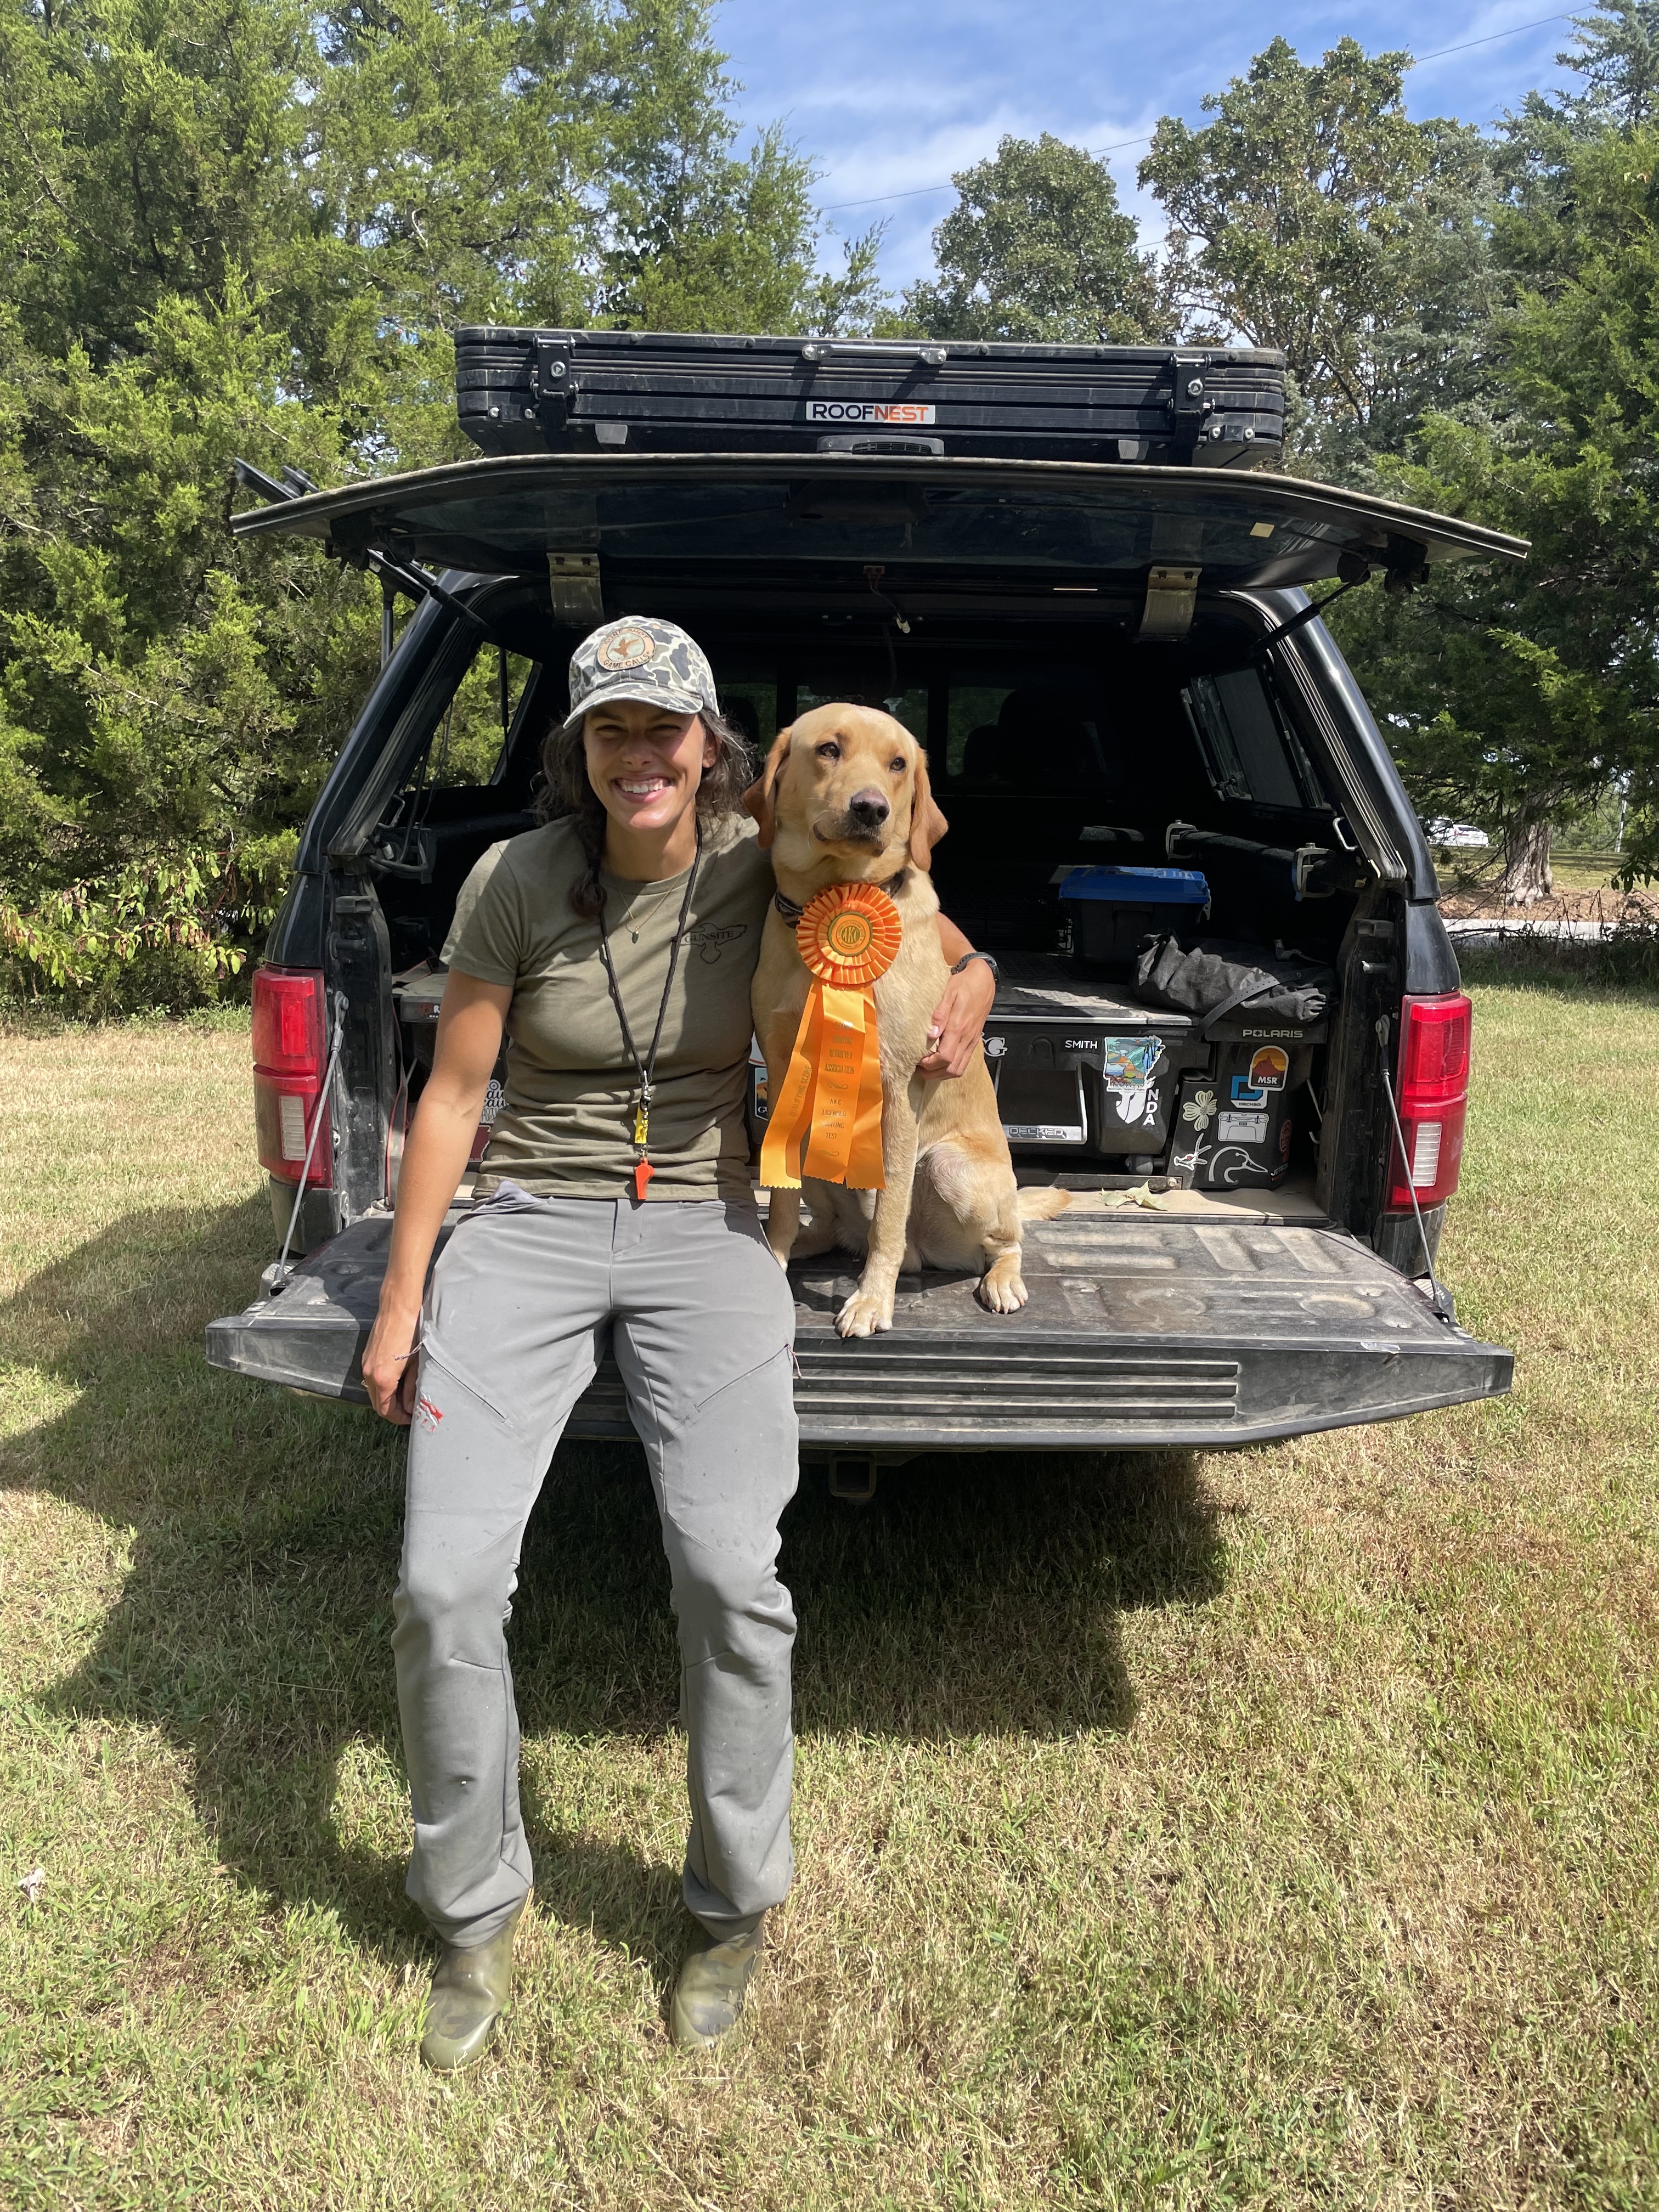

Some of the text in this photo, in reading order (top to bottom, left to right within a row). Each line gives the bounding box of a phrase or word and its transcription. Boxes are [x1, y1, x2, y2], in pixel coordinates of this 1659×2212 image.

[812, 403, 929, 422] ROOFNEST
[603, 659, 624, 669] GAME
[685, 930, 734, 943] GUNSITE
[1243, 1029, 1304, 1038] POLARIS
[1065, 1040, 1098, 1049] SMITH
[829, 1048, 854, 1059] RETRIEVER
[824, 1063, 854, 1075] ASSOCIATION
[1257, 1076, 1278, 1085] MSR
[789, 1066, 812, 1118] QUALIFYING SCORE
[1143, 1088, 1160, 1126] NDA
[1009, 1127, 1067, 1139] DECKED
